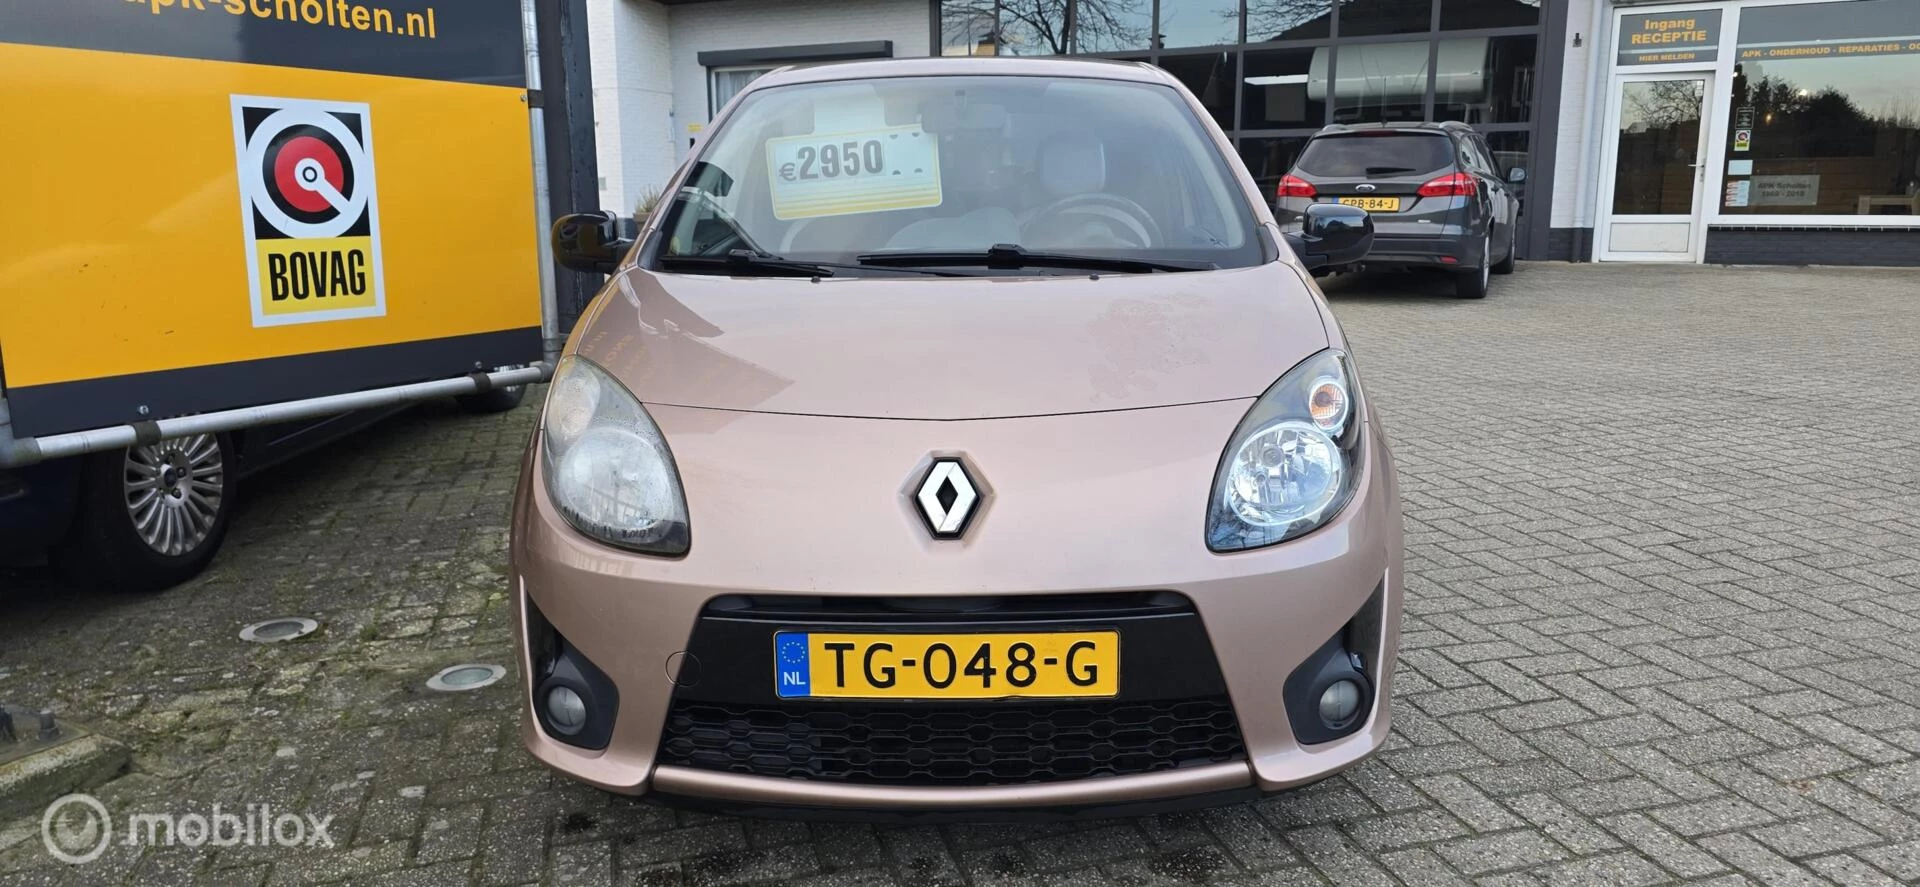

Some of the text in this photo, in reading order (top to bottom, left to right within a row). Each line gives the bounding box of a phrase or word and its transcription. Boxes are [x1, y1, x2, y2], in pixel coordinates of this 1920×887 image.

[125, 0, 435, 39] pscholten.nl
[1644, 18, 1696, 31] Ingang
[1631, 30, 1707, 45] RECEPTIE
[1639, 54, 1659, 62] HIER
[1742, 49, 1761, 58] APK
[1769, 47, 1830, 56] ONDERHOUD
[1838, 43, 1900, 53] REPARATIES
[778, 140, 884, 182] €2950
[268, 248, 366, 301] BOVAG
[823, 640, 1099, 690] TG-048-G
[783, 672, 807, 686] NL
